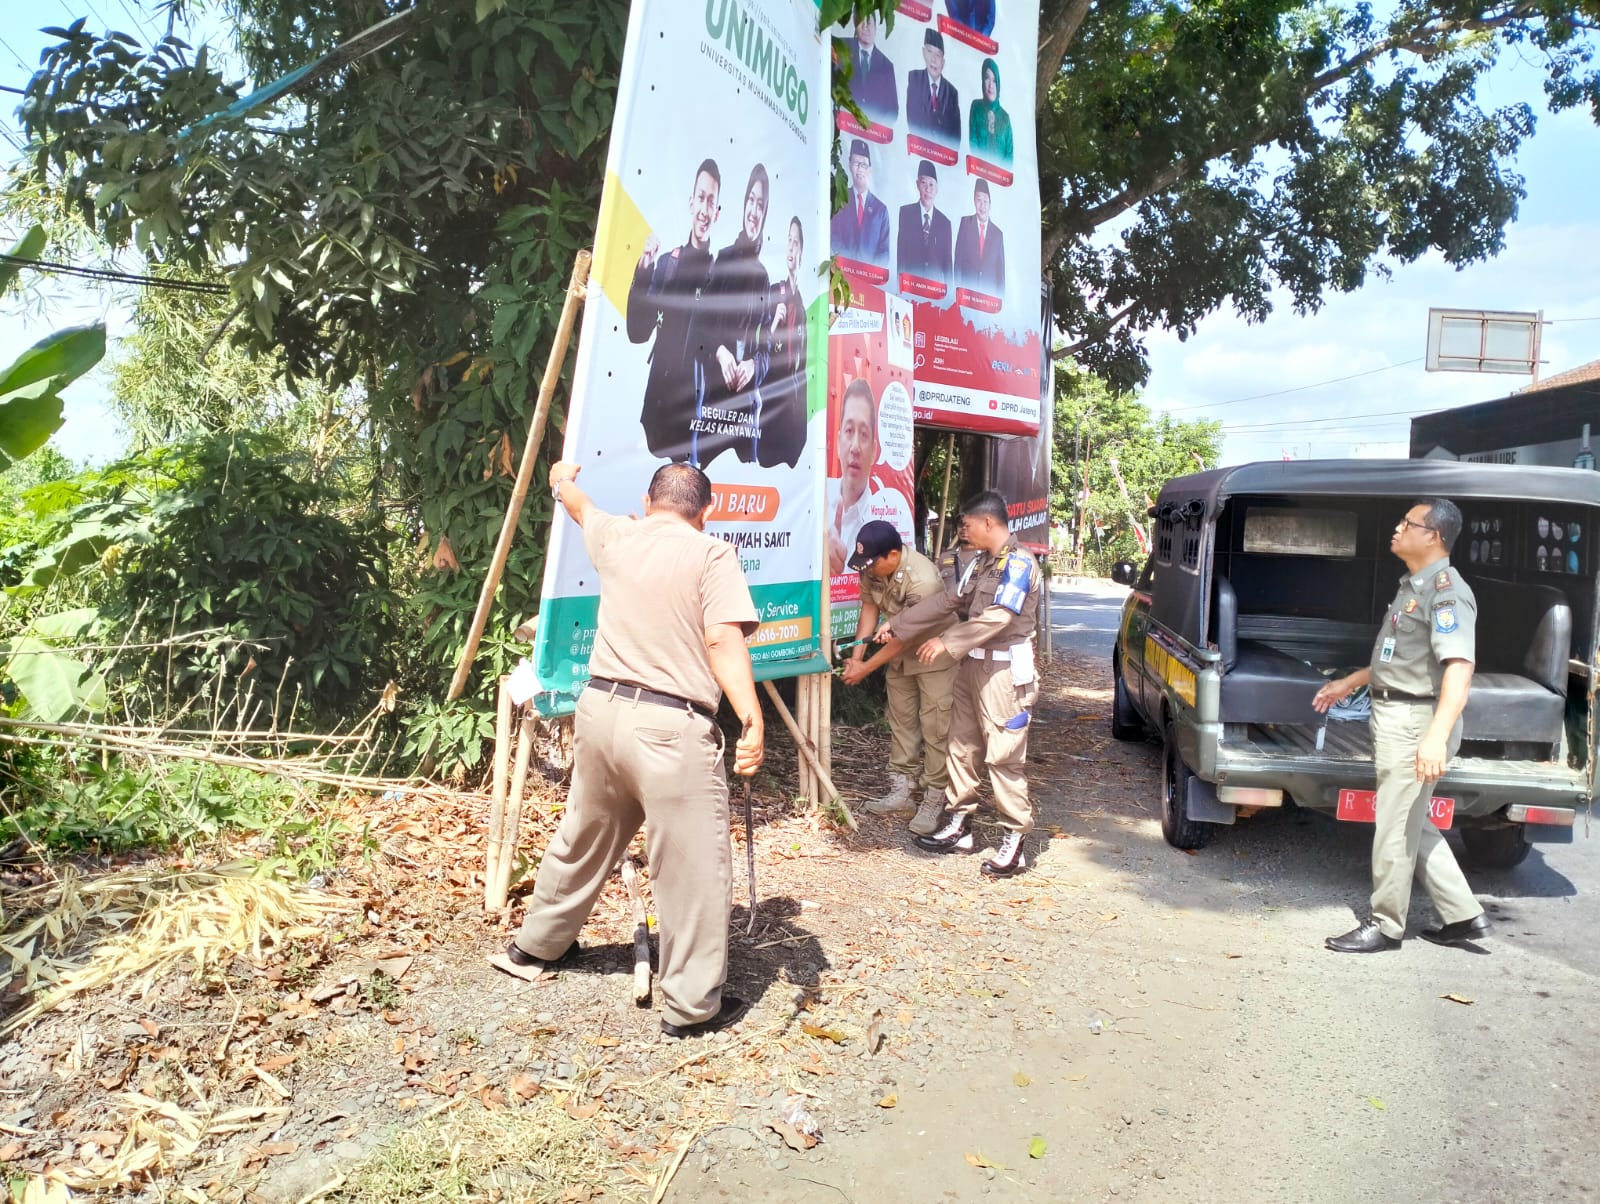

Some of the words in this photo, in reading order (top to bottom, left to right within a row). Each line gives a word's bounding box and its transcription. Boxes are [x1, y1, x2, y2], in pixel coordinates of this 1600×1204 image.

[700, 40, 747, 86] UNIVERSITAS
[705, 0, 808, 125] UNIMUGO
[919, 390, 971, 406] @DPRDJATENG
[701, 406, 738, 422] REGULER
[737, 412, 754, 425] DAN
[1001, 402, 1018, 413] DPRD
[690, 419, 717, 434] KELAS
[717, 422, 762, 439] KARYAWAN
[728, 494, 766, 513] BARU
[1023, 511, 1047, 530] GANJAR
[764, 531, 791, 548] SAKIT
[766, 600, 799, 618] Service
[843, 609, 856, 622] DPR
[1345, 792, 1355, 810] R
